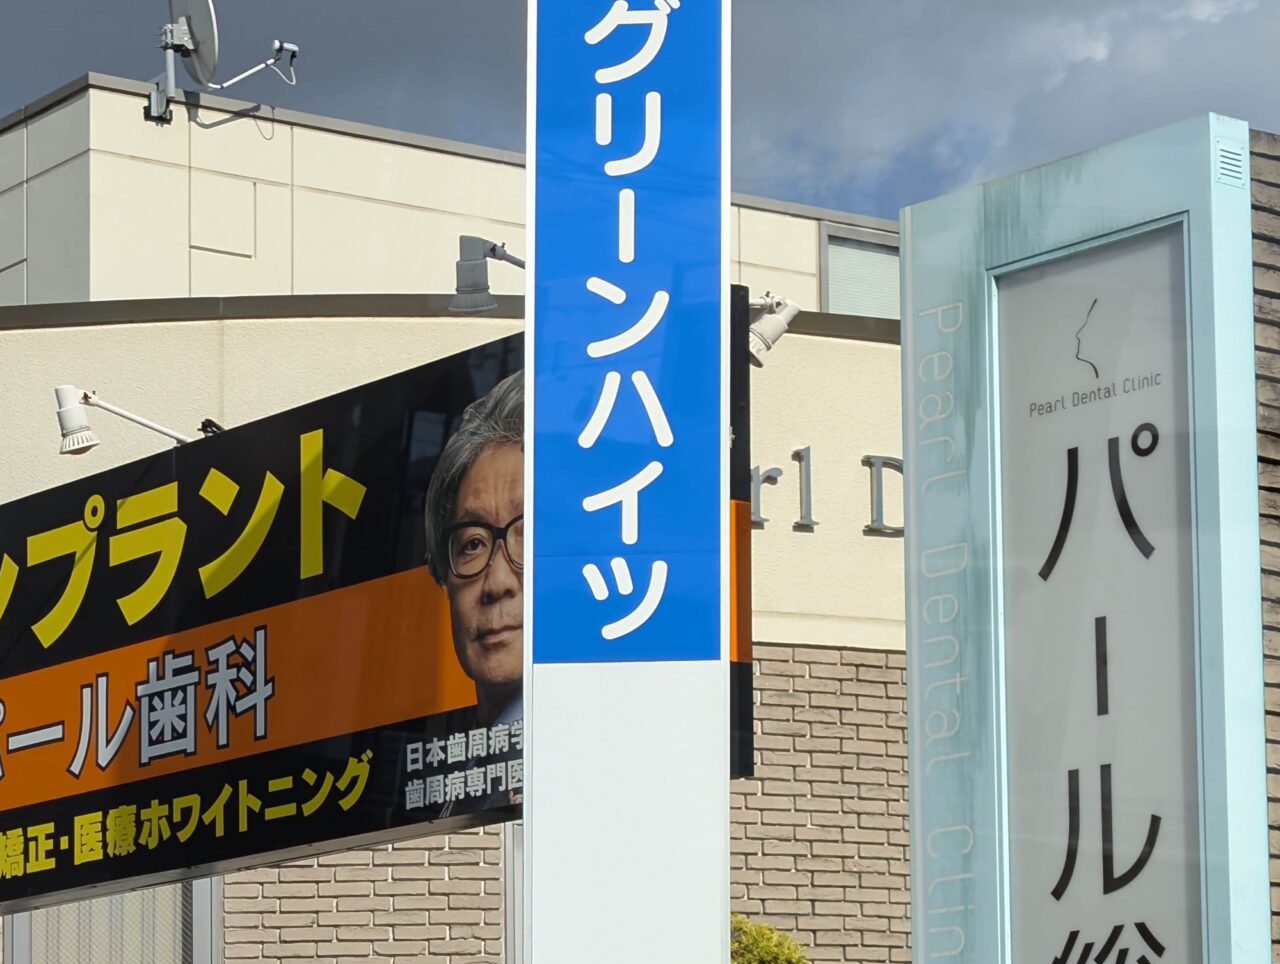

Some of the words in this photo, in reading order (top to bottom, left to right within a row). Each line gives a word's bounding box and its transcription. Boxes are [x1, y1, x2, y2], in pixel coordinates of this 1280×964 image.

[578, 0, 681, 640] グリーンハイツ
[918, 301, 967, 495] Pearl
[1029, 396, 1066, 418] Pearl
[1072, 382, 1118, 407] Dental
[1122, 372, 1162, 394] Clinic
[922, 541, 971, 775] Dental
[405, 758, 523, 810] 歯周病専門医
